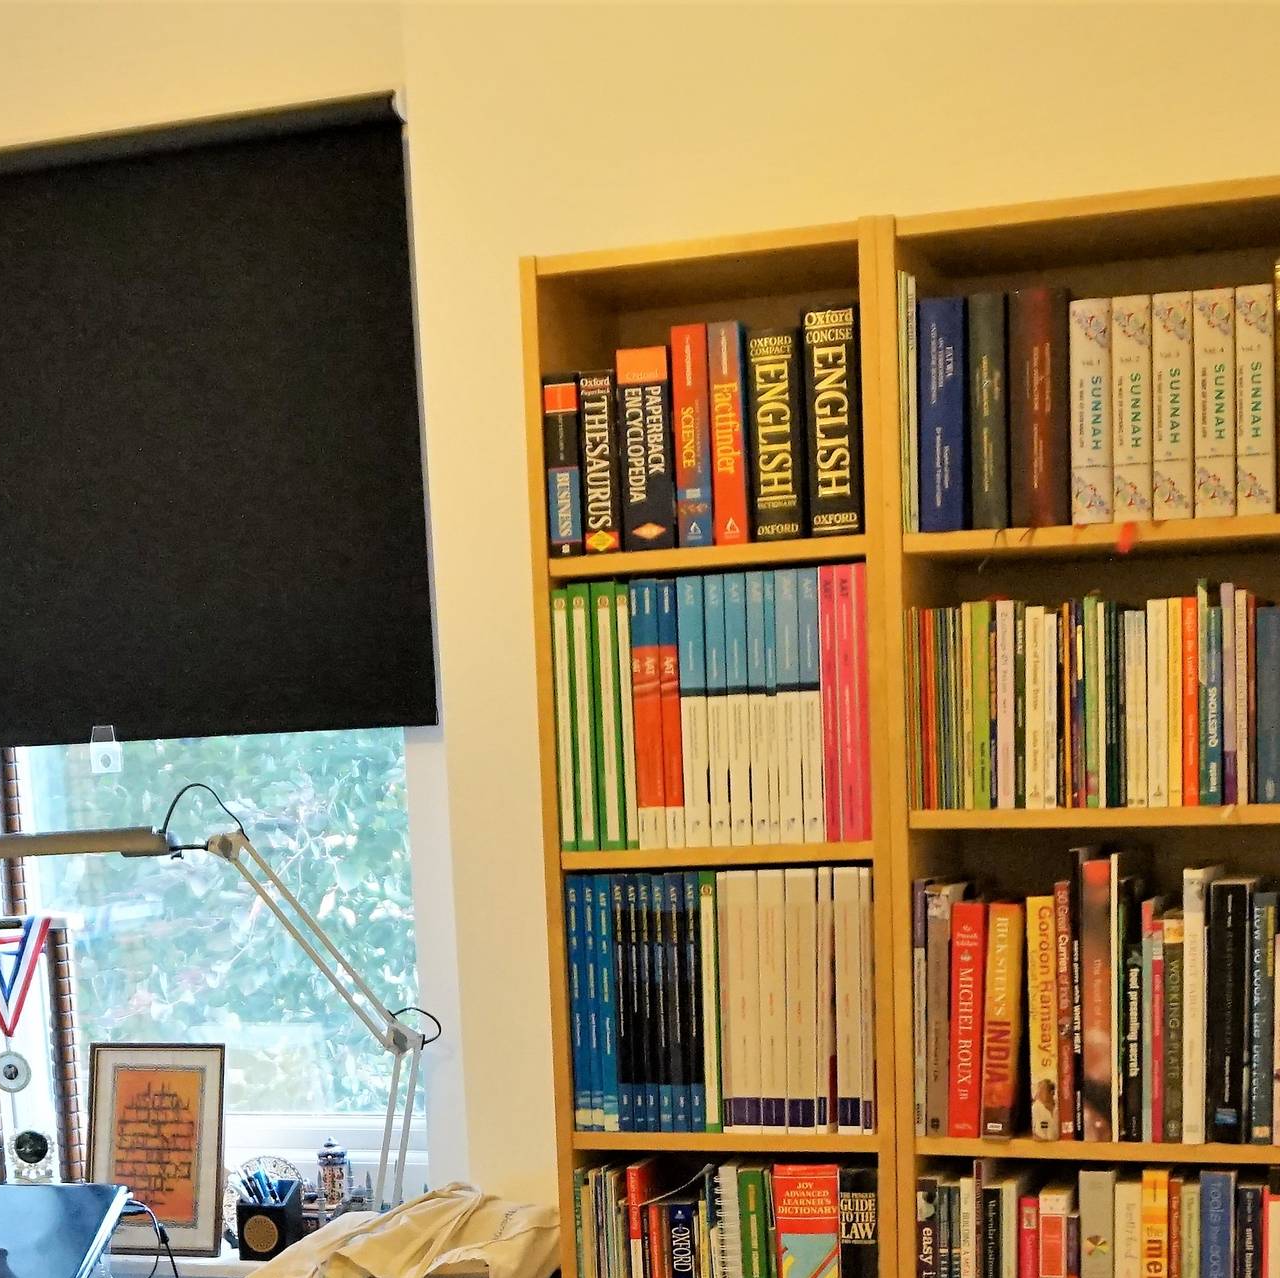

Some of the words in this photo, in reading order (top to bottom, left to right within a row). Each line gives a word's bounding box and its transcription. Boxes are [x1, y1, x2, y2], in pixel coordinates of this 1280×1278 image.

[750, 336, 792, 348] OXFORD
[805, 308, 853, 326] Oxford
[806, 328, 852, 344] CONCISE
[580, 376, 610, 387] Oxford
[1169, 368, 1180, 444] SUNNAH
[1214, 364, 1226, 440] SUNNAH
[1251, 362, 1262, 438] SUNNAH
[645, 385, 665, 474] PAPERBACK
[680, 406, 696, 469] SCIENCE
[713, 382, 739, 474] Factfinder
[755, 360, 793, 499] ENGLISH
[812, 345, 850, 498] ENGLISH
[1091, 376, 1102, 450] SUNNAH
[1130, 373, 1141, 448] SUNNAH
[584, 396, 611, 531] THESAURUS
[625, 387, 646, 503] ENCYCLOPEDIA
[557, 472, 572, 536] BUSINESS
[758, 523, 799, 536] OXFORD
[813, 512, 857, 525] OXFORD
[1208, 686, 1218, 747] QUESTIONS
[995, 916, 1009, 954] RICK
[1038, 905, 1054, 975] Gordon
[1058, 934, 1069, 973] Curries
[959, 968, 973, 1035] MICHEL
[995, 958, 1008, 1017] STEIN'S
[1129, 968, 1140, 989] food
[1038, 981, 1055, 1068] Ramsay's
[1072, 1005, 1081, 1030] WHITE
[1126, 991, 1140, 1041] presenting
[957, 1039, 973, 1085] ROUX
[985, 1020, 1011, 1085] INDIA
[1129, 1043, 1139, 1077] secrets
[841, 1199, 875, 1211] GUIDE
[842, 1212, 853, 1222] TO
[854, 1212, 875, 1222] THE
[1209, 1182, 1223, 1224] tools
[672, 1227, 692, 1272] OXFORD
[841, 1223, 875, 1239] LAW
[920, 1227, 934, 1265] easy
